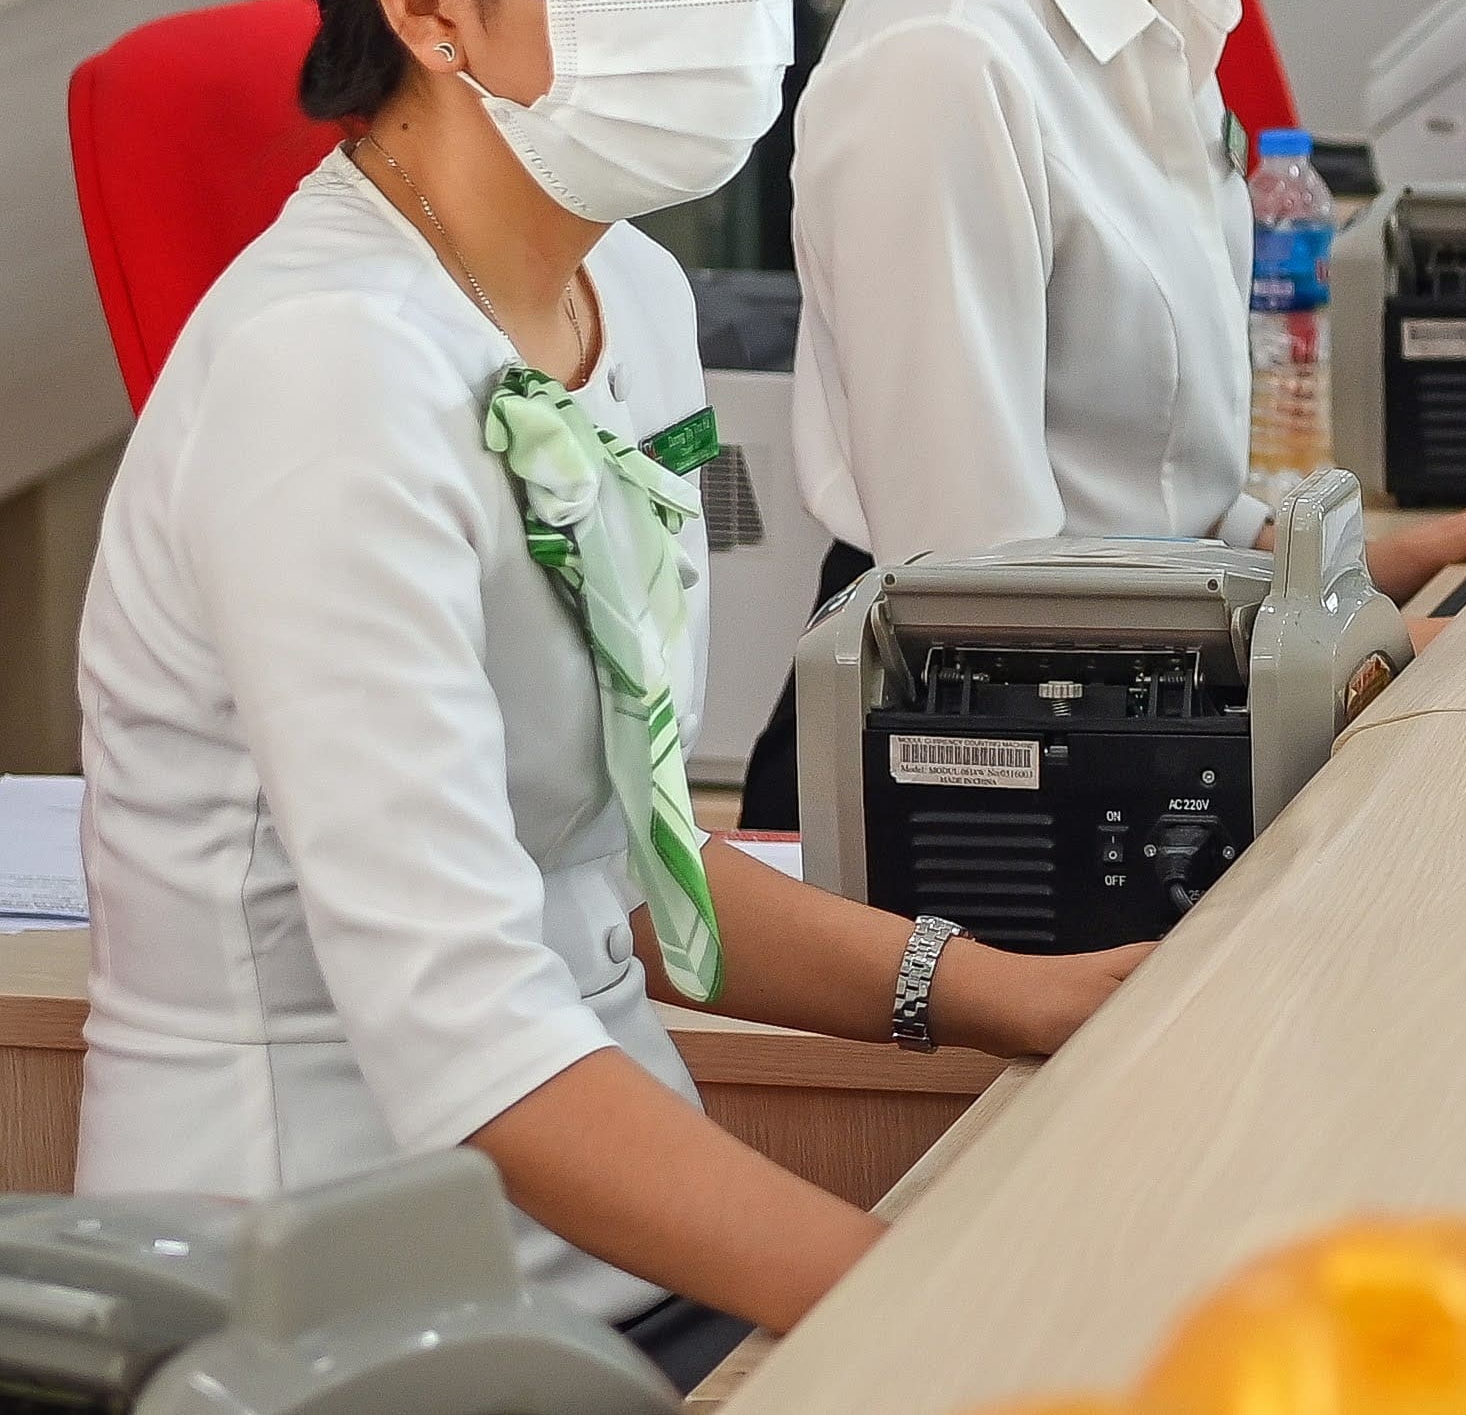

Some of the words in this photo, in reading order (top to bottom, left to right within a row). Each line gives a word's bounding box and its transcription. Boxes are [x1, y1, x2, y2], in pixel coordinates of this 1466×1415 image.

[1169, 799, 1210, 810] AC220V
[1106, 811, 1121, 822] ON
[1104, 875, 1127, 886] OFF
